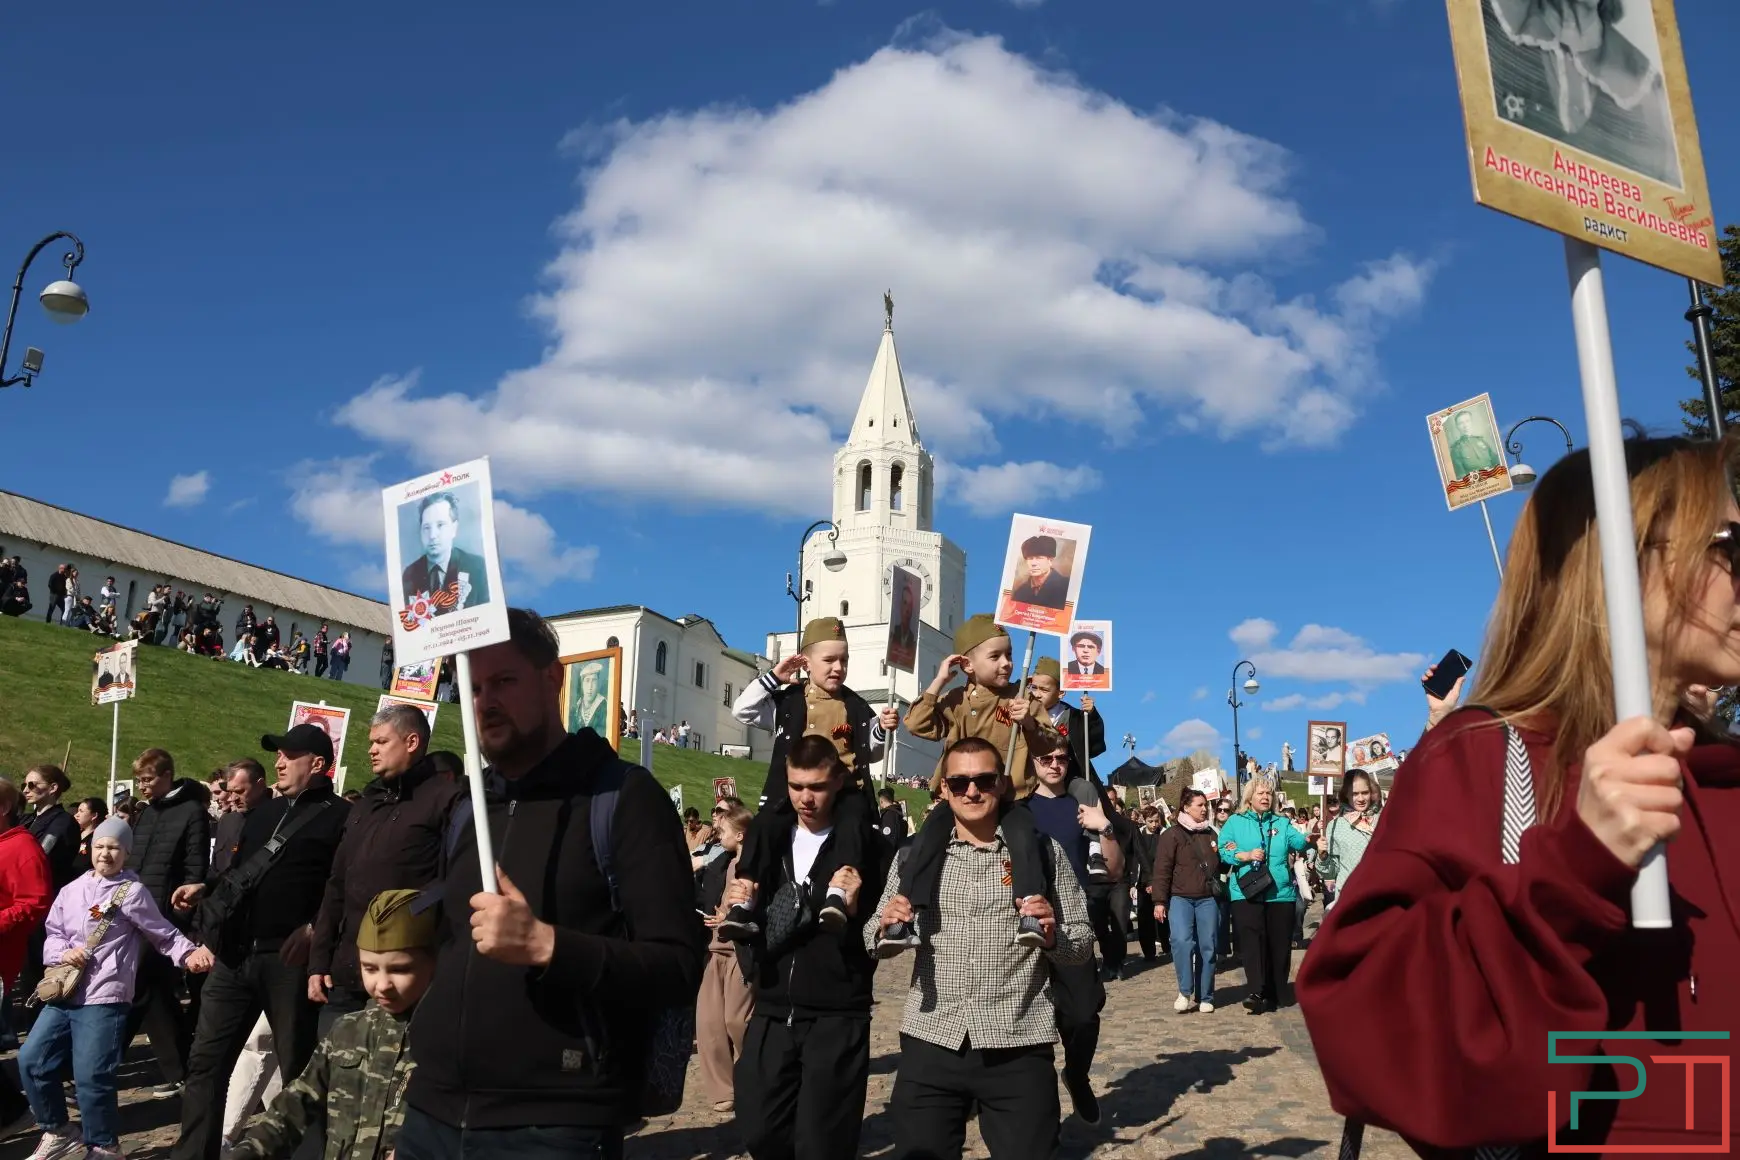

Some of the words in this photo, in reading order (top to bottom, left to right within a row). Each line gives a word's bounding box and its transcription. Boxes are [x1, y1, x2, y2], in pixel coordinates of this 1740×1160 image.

[1484, 146, 1600, 209] Александра
[1605, 191, 1709, 249] Васильевна
[1553, 149, 1642, 203] Андреева
[1584, 216, 1628, 243] радист
